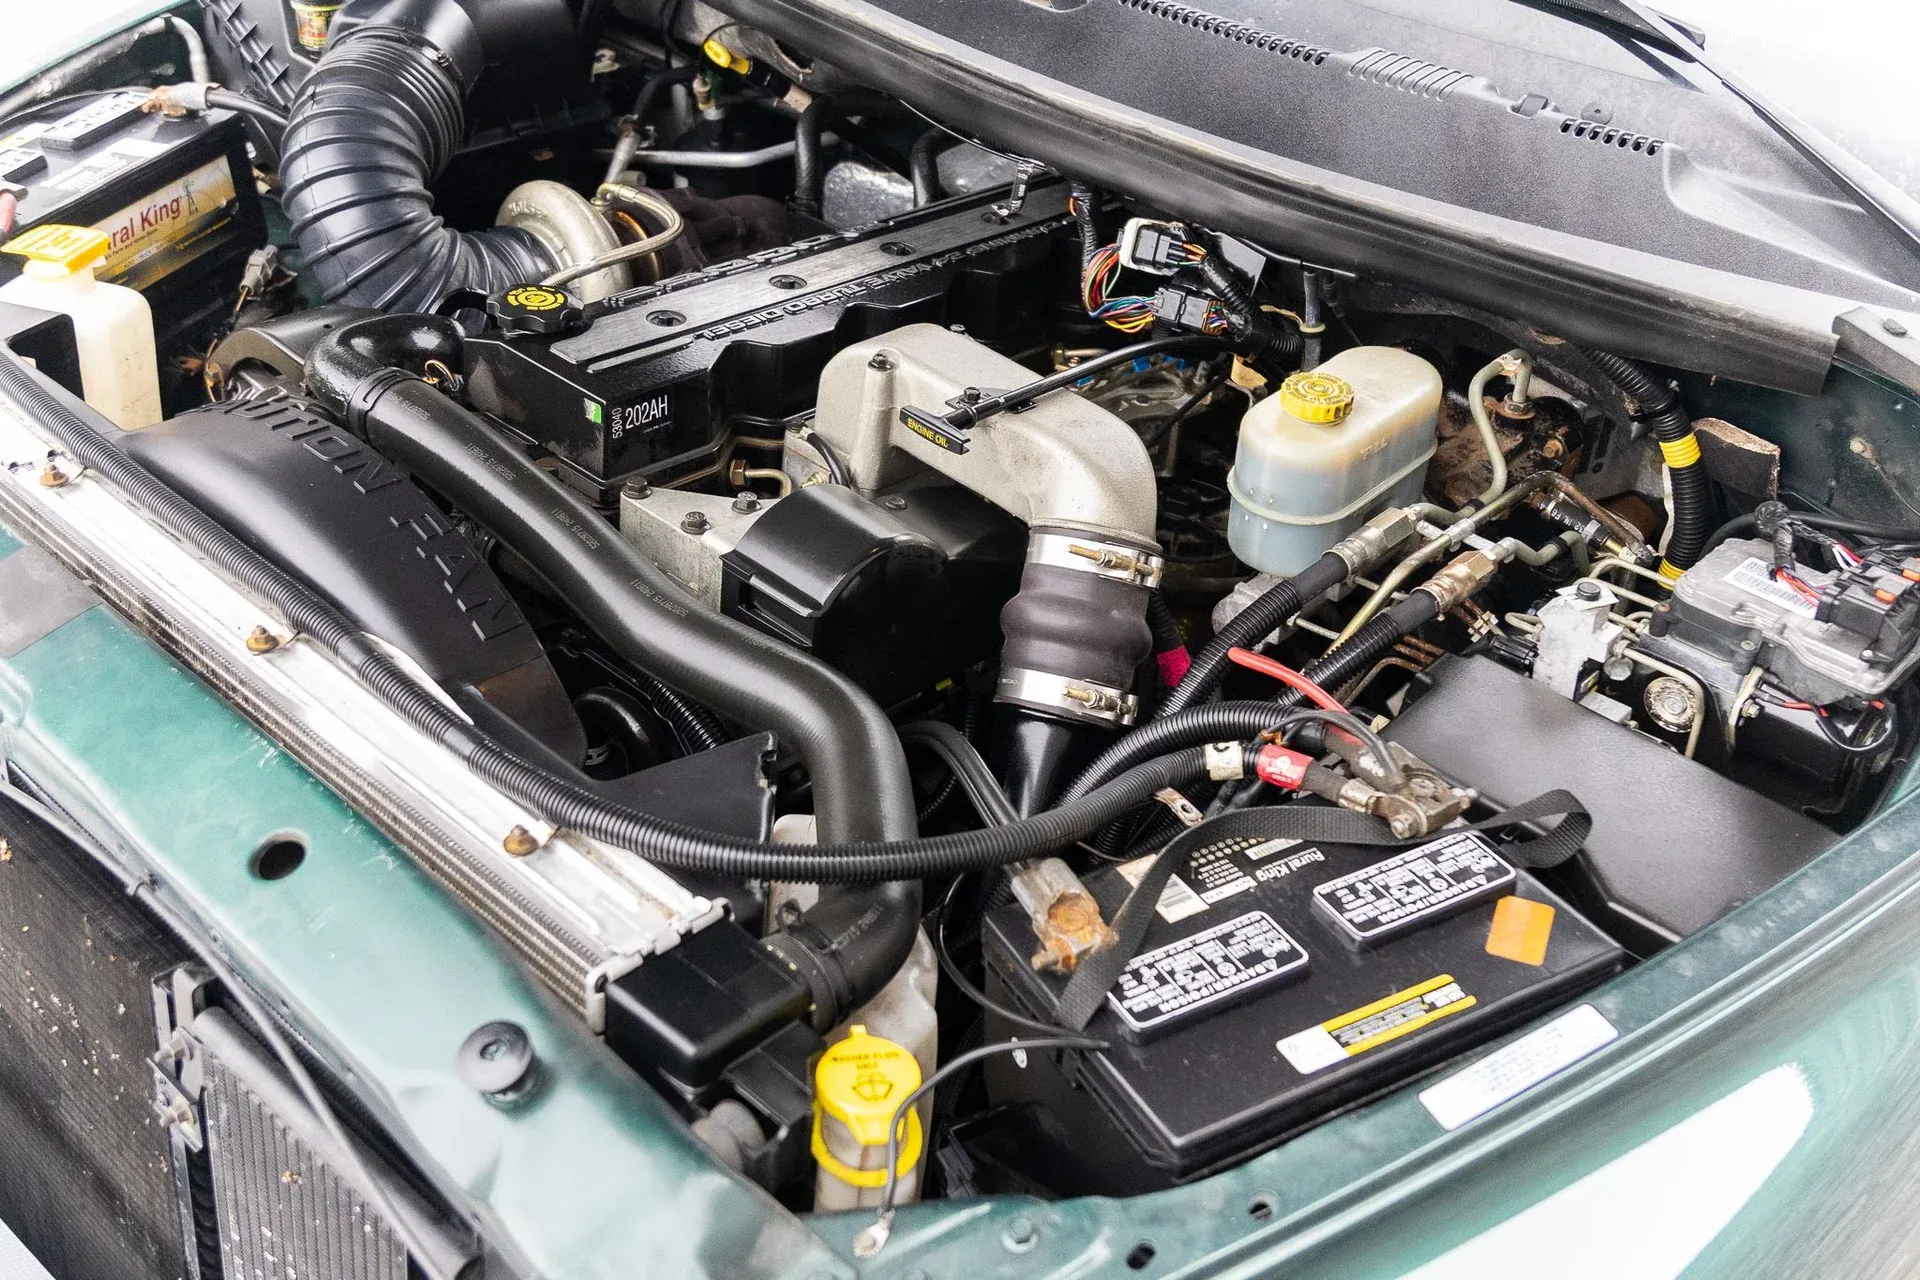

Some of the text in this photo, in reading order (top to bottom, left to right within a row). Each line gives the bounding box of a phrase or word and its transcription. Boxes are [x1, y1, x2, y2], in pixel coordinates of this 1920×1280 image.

[107, 218, 135, 251] ral
[140, 196, 181, 231] King
[866, 262, 935, 292] VALVE
[783, 282, 867, 315] TURBO
[699, 310, 785, 341] DIESEL
[611, 407, 622, 439] 53040
[625, 394, 668, 430] 202AH
[906, 417, 948, 448] ENGINE OIL
[390, 509, 524, 642] FAN
[1254, 859, 1290, 885] King
[1286, 848, 1325, 873] Rural
[1376, 877, 1477, 924] DANGER/POISON
[1157, 962, 1267, 1014] DANGER/POISON
